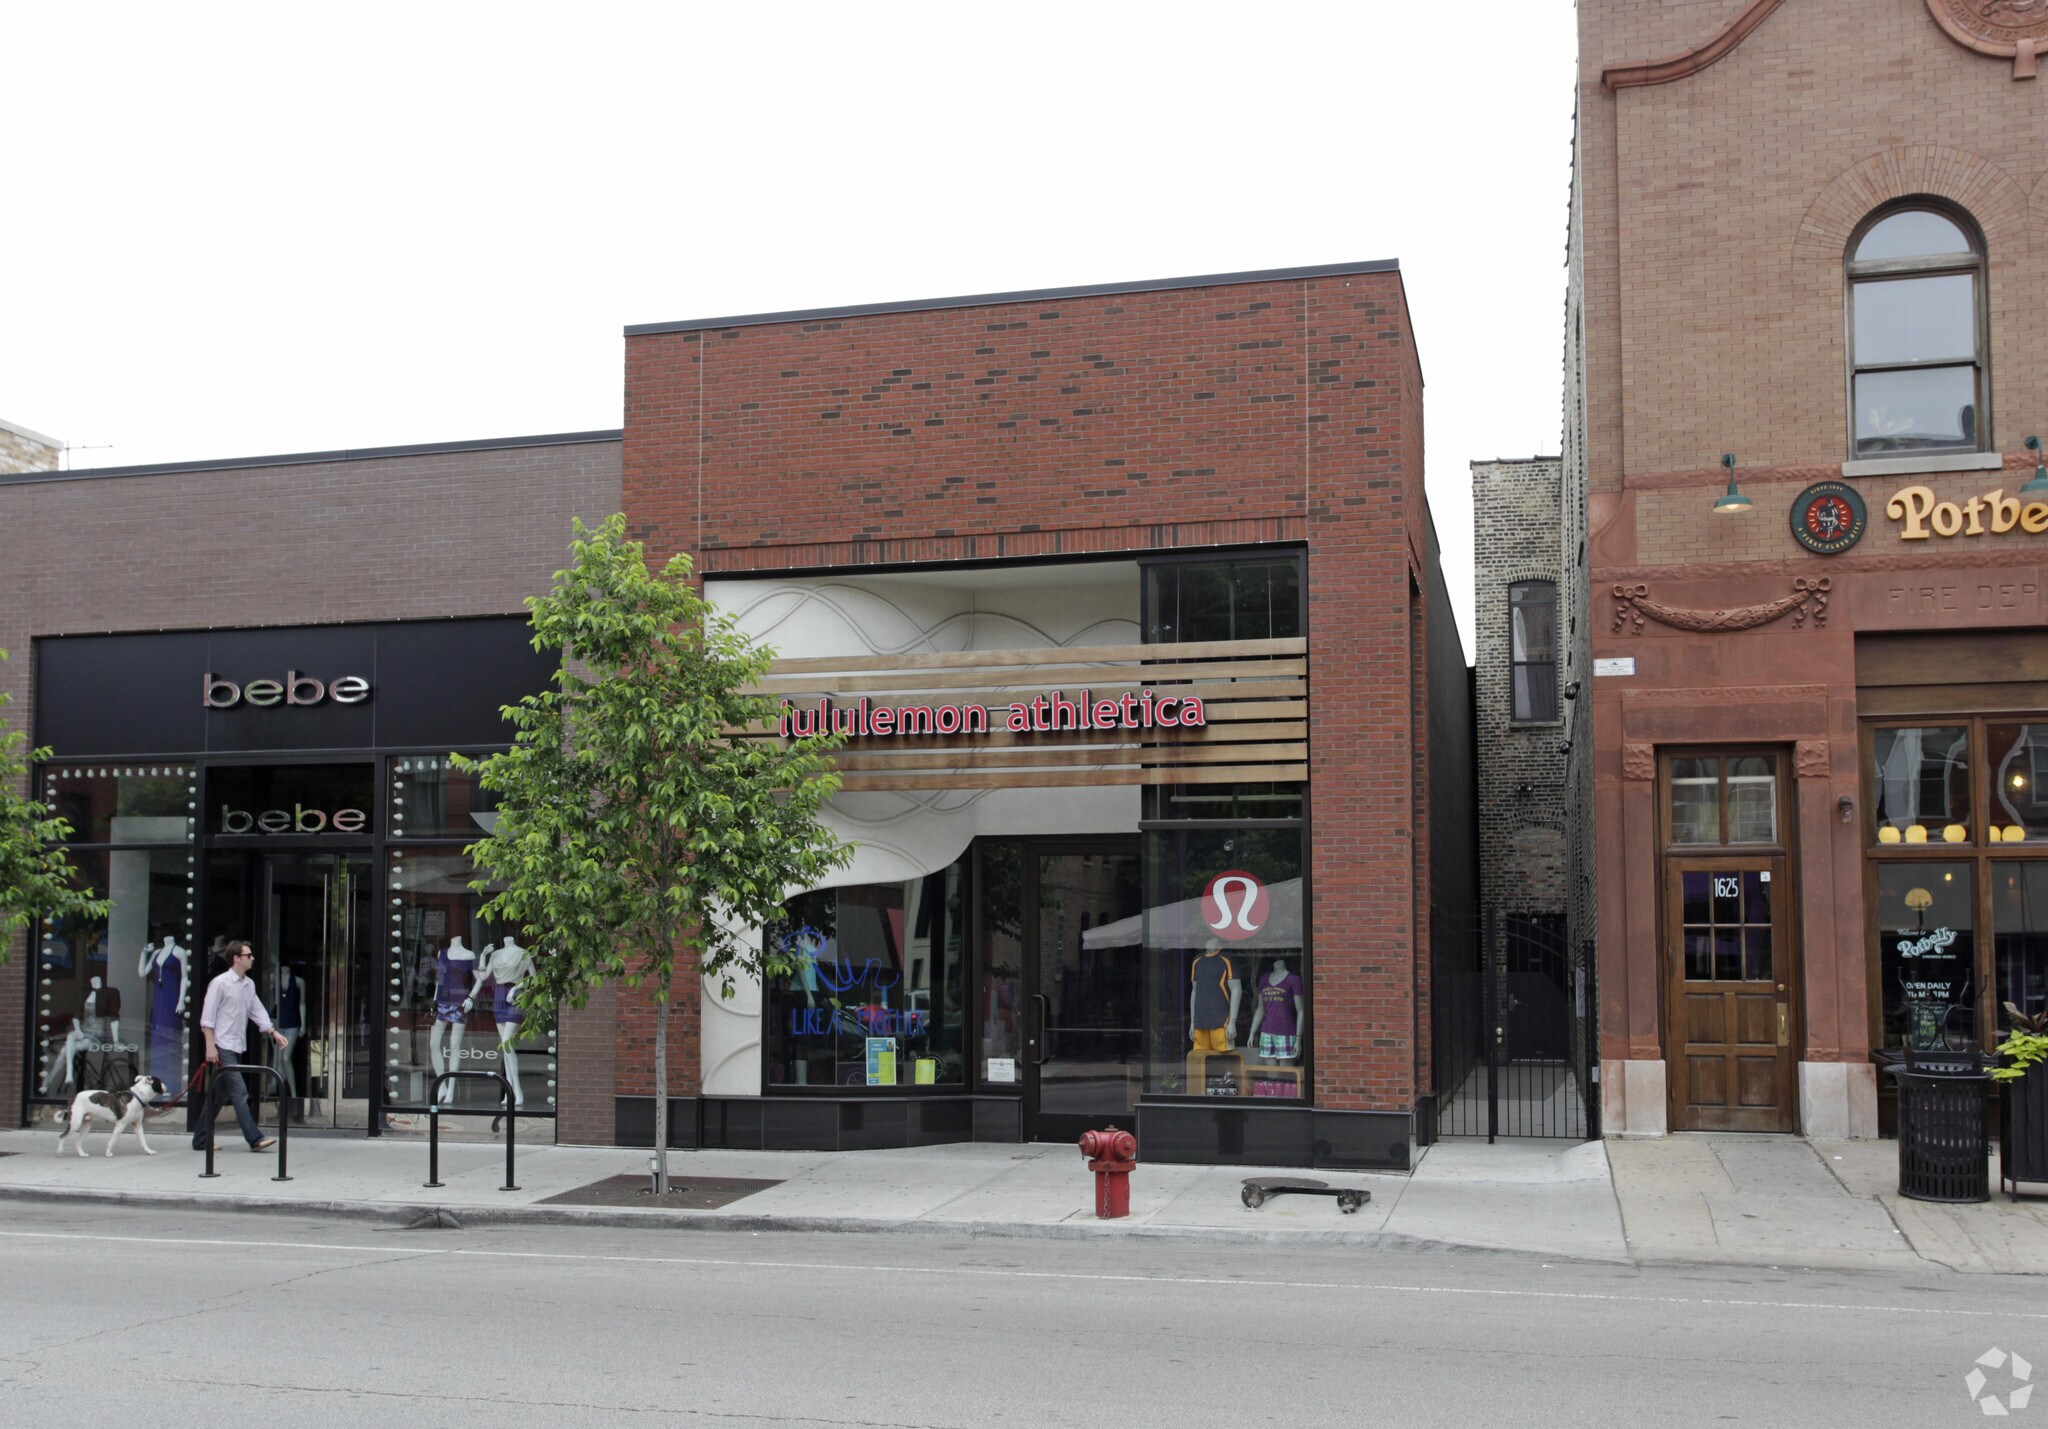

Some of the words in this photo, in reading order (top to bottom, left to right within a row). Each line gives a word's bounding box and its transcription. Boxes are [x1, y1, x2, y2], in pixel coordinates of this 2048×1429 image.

[1946, 0, 2019, 42] ORPORATED
[1825, 539, 1849, 550] CLASS
[1888, 586, 1957, 613] FIRE
[203, 670, 370, 708] bebe
[779, 696, 988, 738] lululemon
[1006, 688, 1206, 732] athletica
[222, 803, 366, 834] bebe
[1714, 878, 1739, 898] 1625
[1896, 926, 1958, 958] Potbelly
[1927, 982, 1951, 990] DAILY
[792, 1008, 824, 1035] LIKE
[827, 1008, 844, 1035] A
[442, 1047, 498, 1060] bebe
